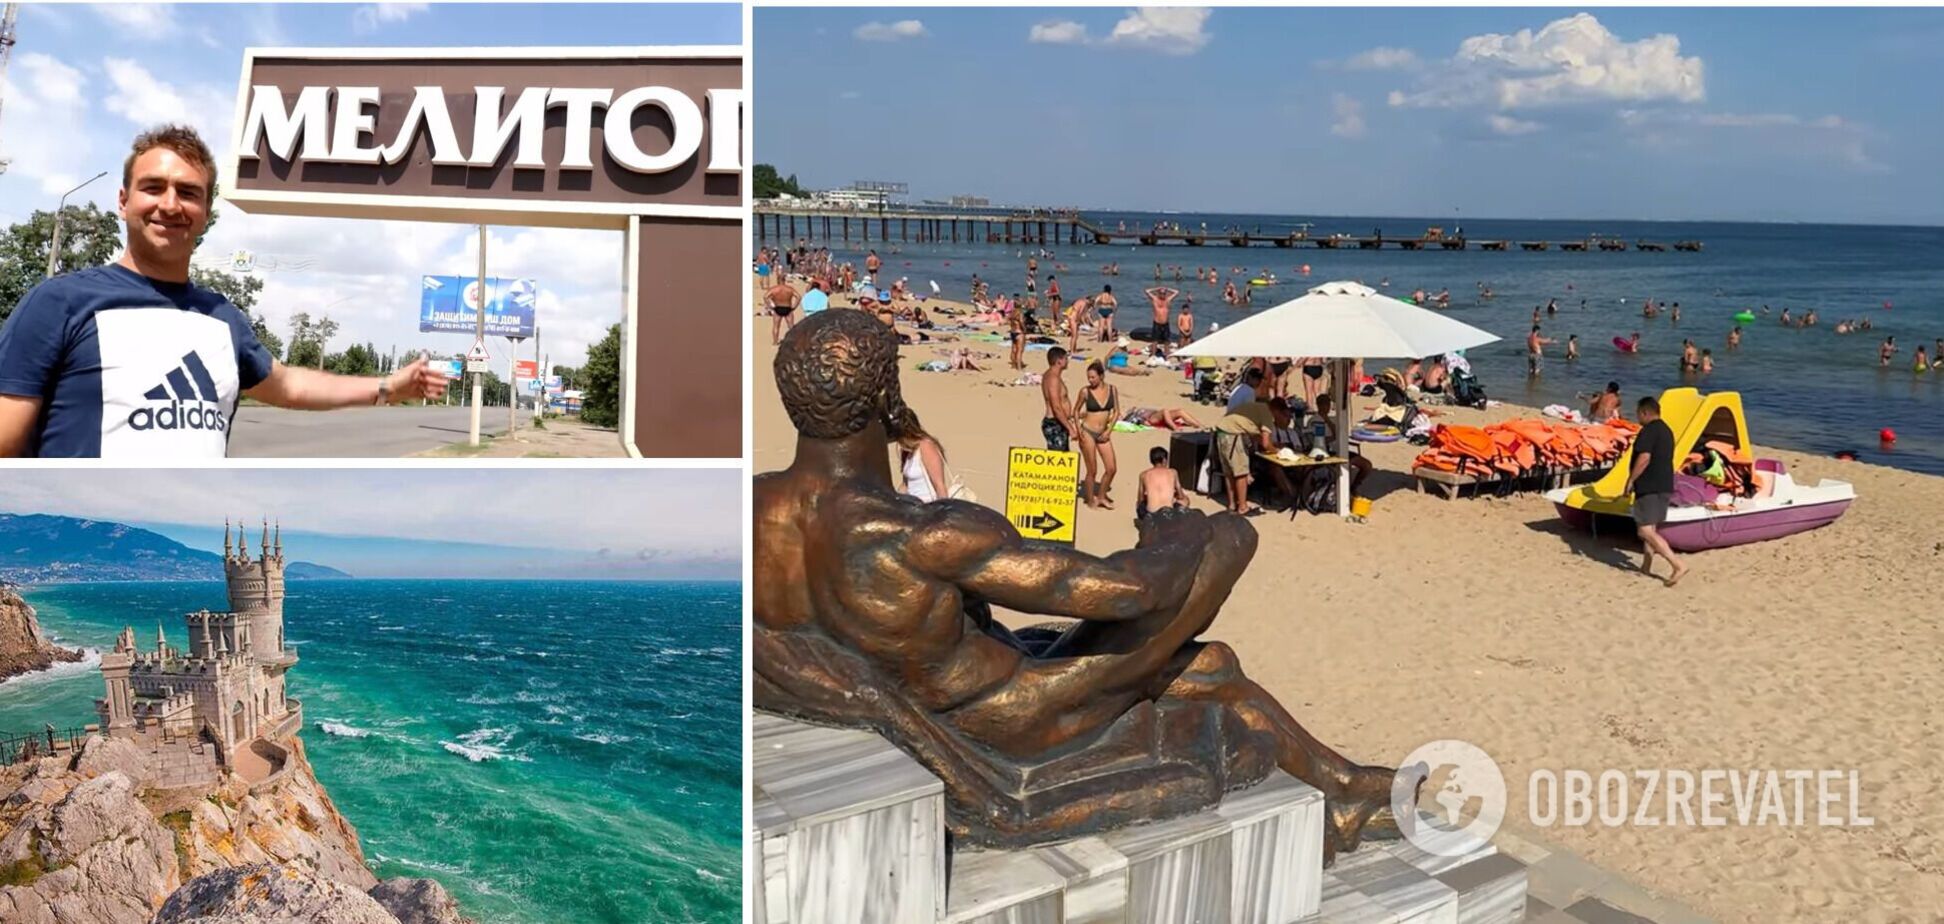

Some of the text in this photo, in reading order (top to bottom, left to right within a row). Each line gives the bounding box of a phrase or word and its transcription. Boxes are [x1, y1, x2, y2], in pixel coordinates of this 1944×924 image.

[500, 315, 521, 325] ДОМ
[127, 399, 226, 431] adidas
[1013, 452, 1075, 468] ПРОКАТ
[1012, 471, 1075, 483] КАТАМАРАНОВ
[1010, 481, 1074, 493] ГИДРОЦИКЛОВ
